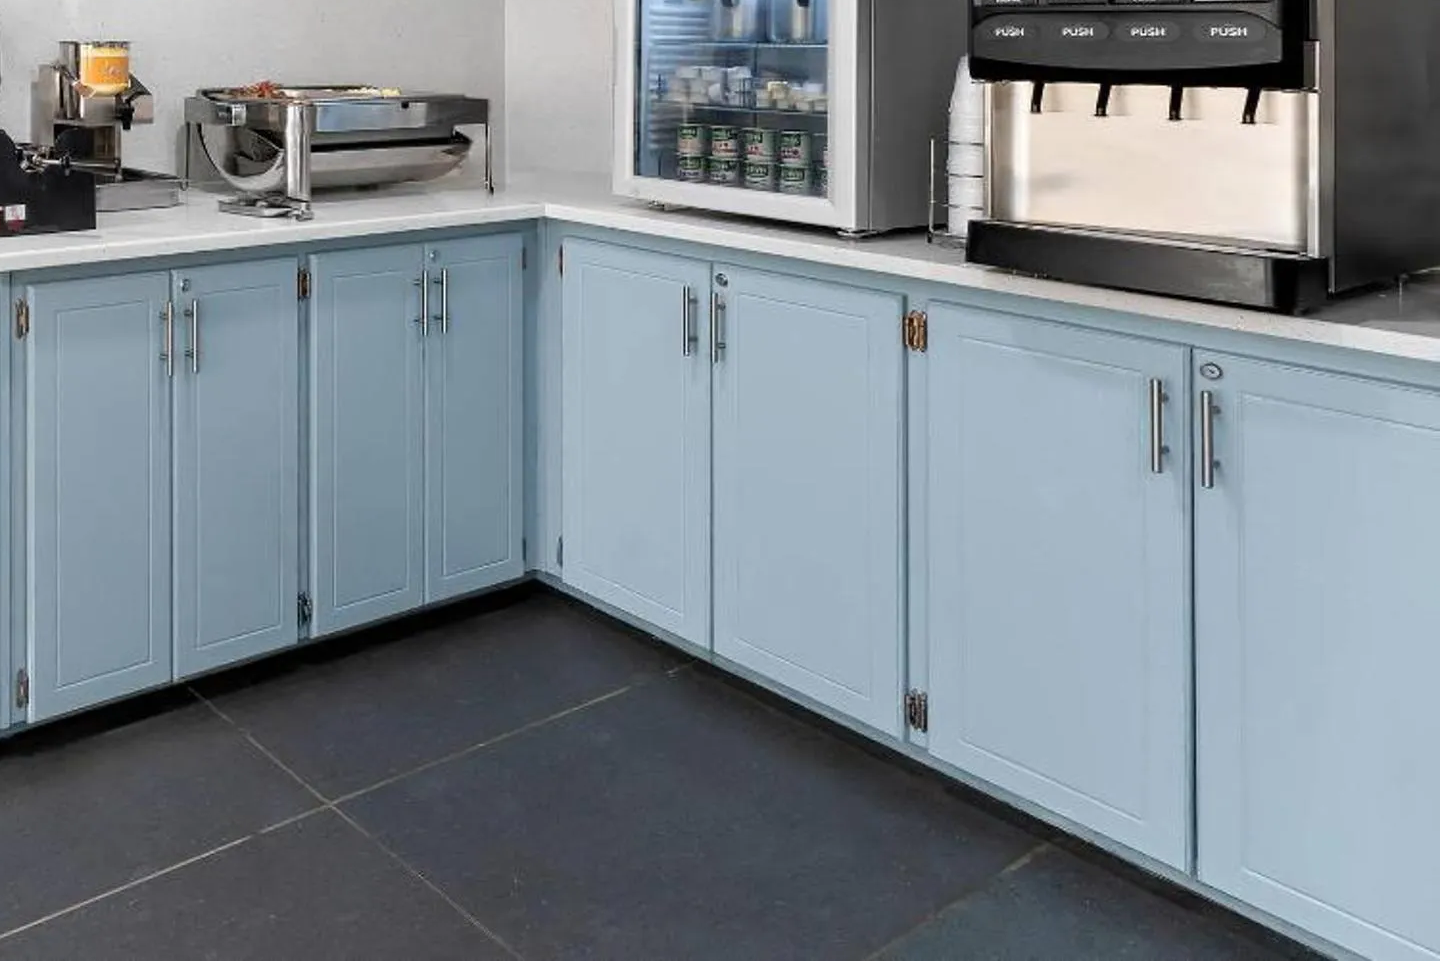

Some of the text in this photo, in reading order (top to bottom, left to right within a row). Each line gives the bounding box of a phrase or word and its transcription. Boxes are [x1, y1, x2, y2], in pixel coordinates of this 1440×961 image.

[994, 26, 1025, 38] PUSH
[1061, 26, 1095, 38] PUSH
[1129, 26, 1166, 37] PUSH
[1209, 26, 1248, 37] PUSH
